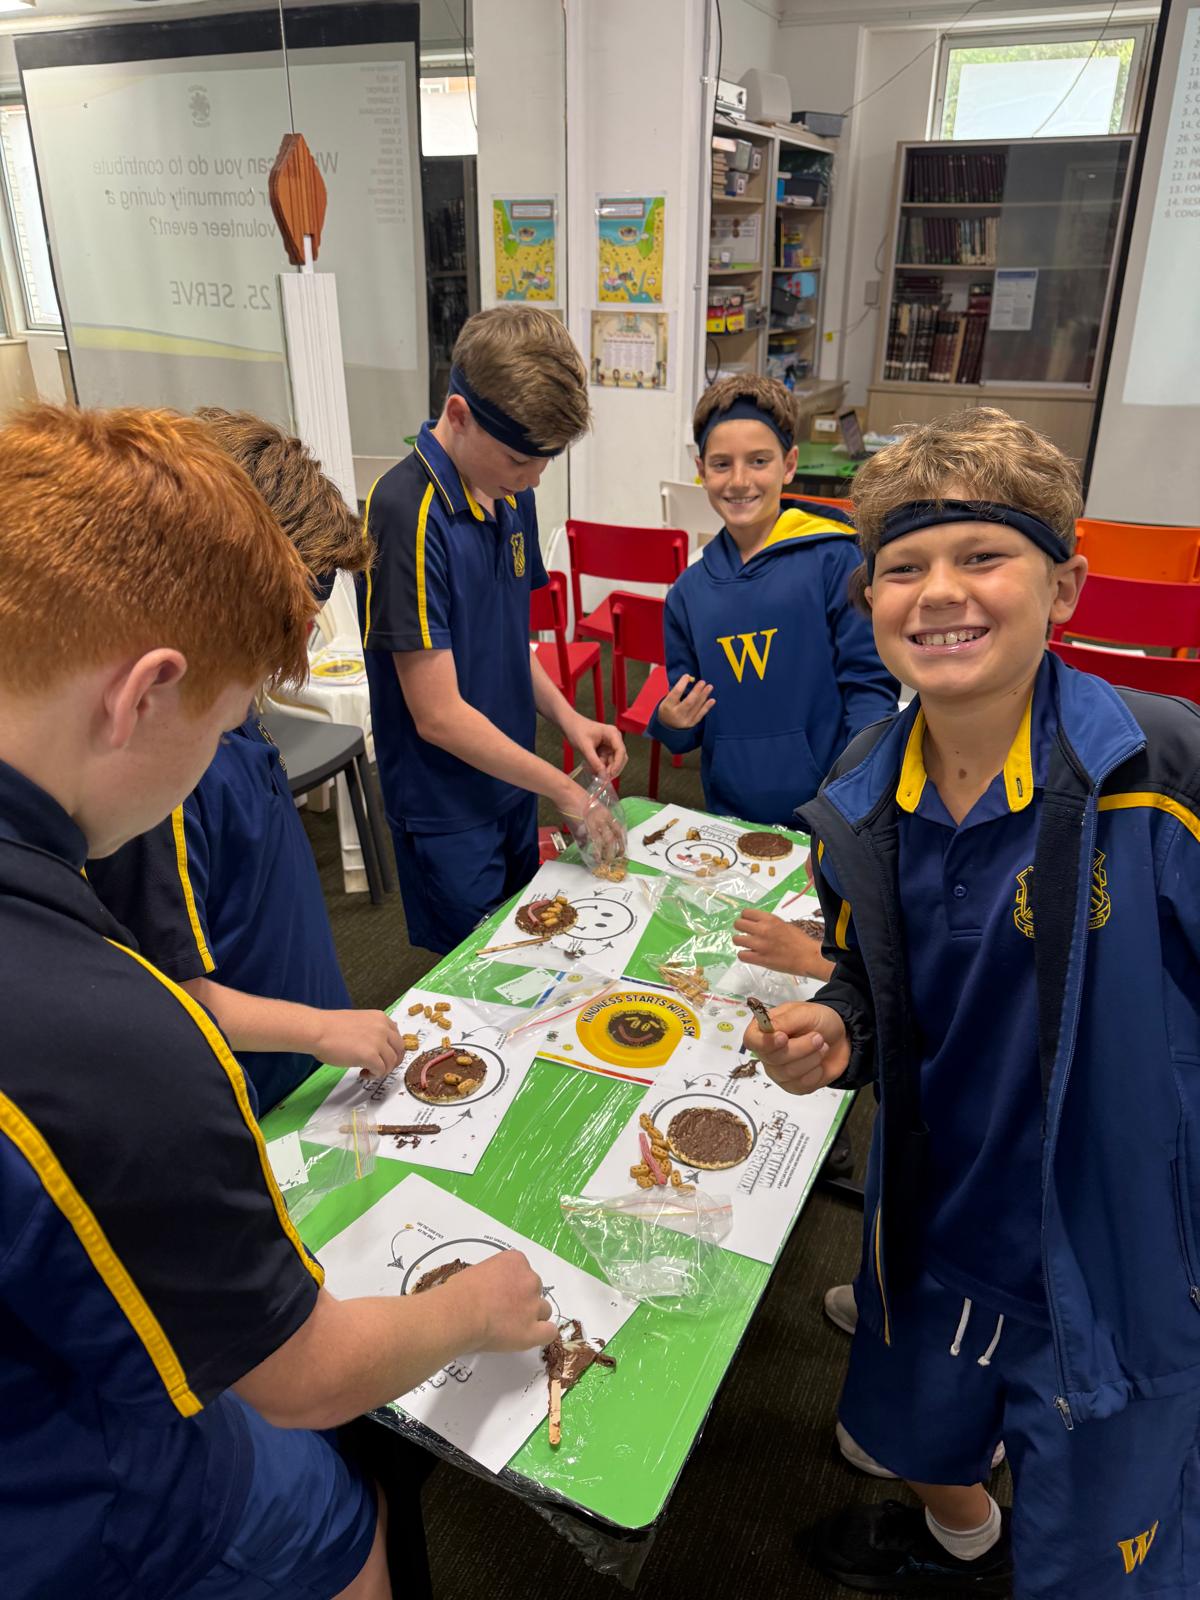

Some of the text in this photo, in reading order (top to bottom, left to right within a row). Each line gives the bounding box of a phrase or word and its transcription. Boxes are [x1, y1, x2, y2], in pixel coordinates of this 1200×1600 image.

[716, 628, 778, 684] W
[580, 995, 623, 1023] KINDNESS
[625, 994, 667, 1006] STARTS
[667, 1002, 688, 1019] WITH
[1117, 1520, 1159, 1574] W
